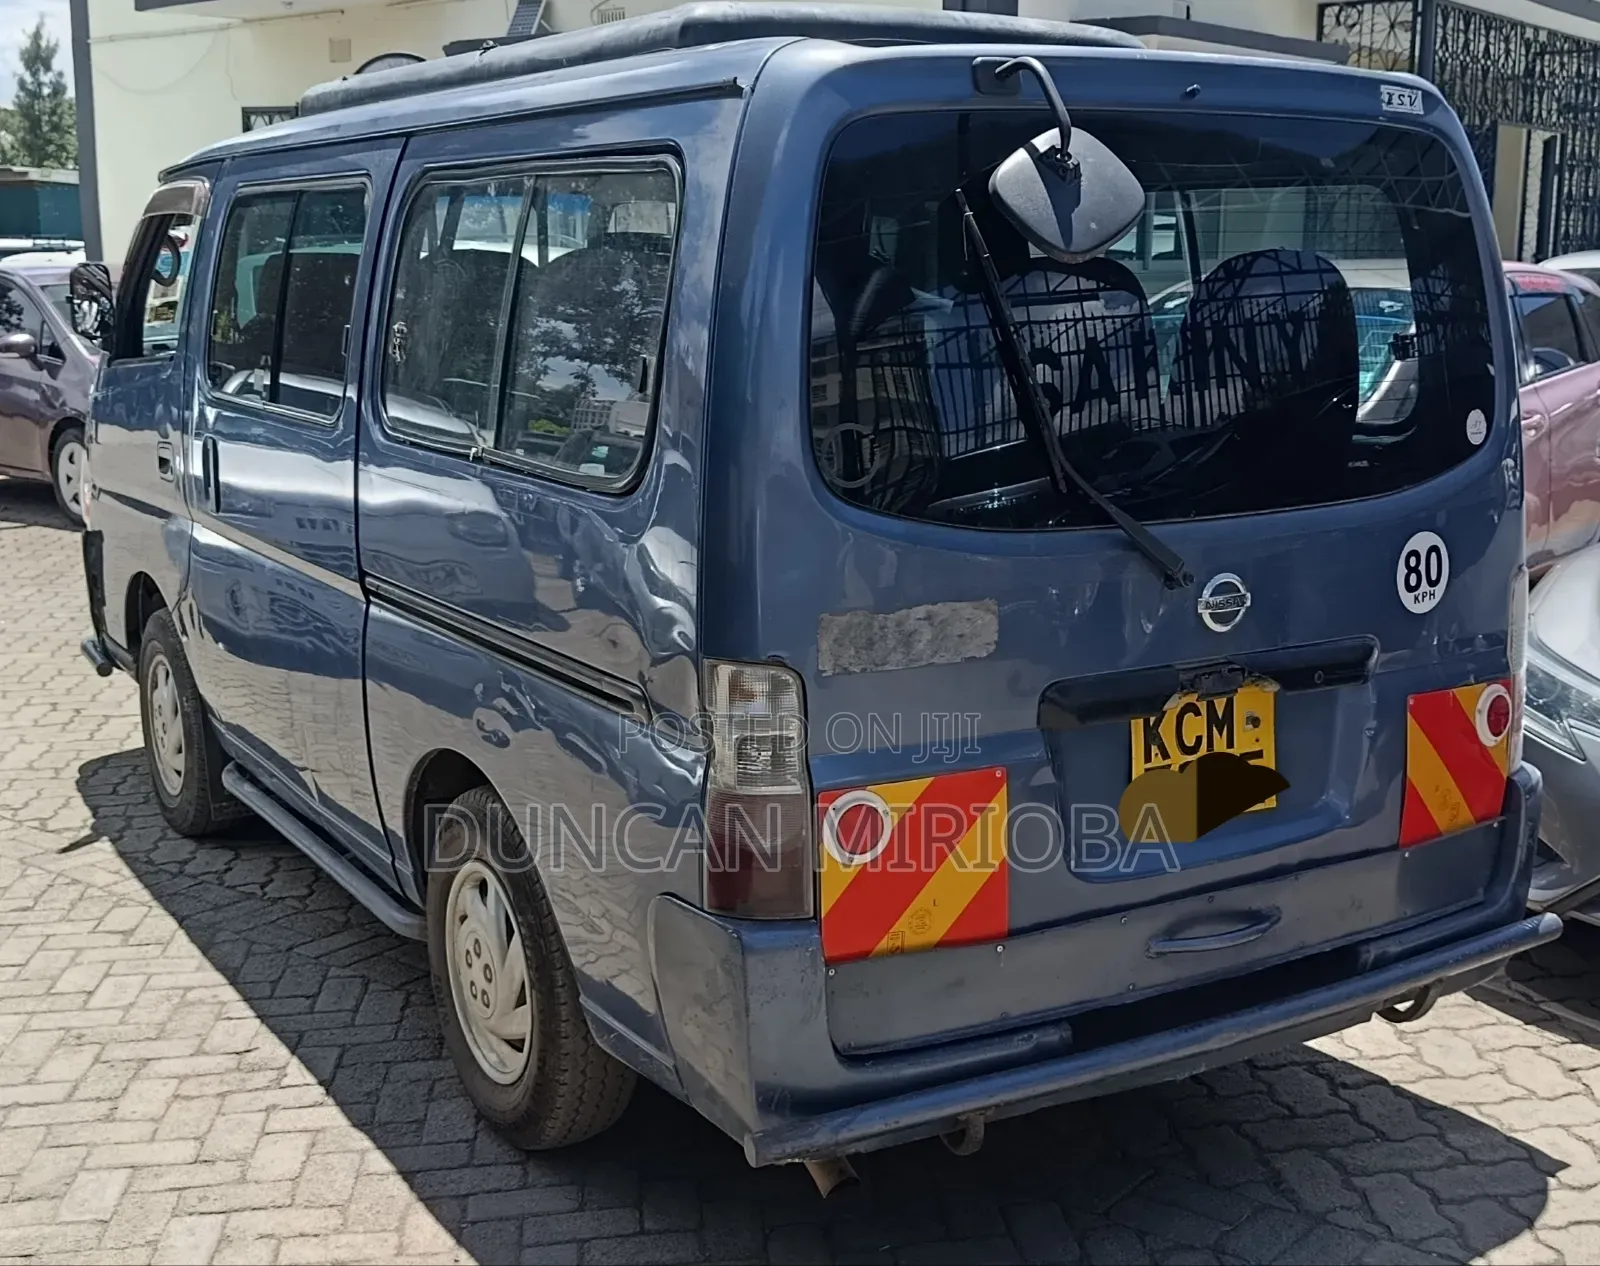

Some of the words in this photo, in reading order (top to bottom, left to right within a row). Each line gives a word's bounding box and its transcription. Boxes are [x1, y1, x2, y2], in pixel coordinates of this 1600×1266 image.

[1404, 544, 1443, 594] 80
[1205, 596, 1247, 611] NISSAN
[1413, 589, 1436, 605] KPH
[1143, 695, 1235, 764] KCM
